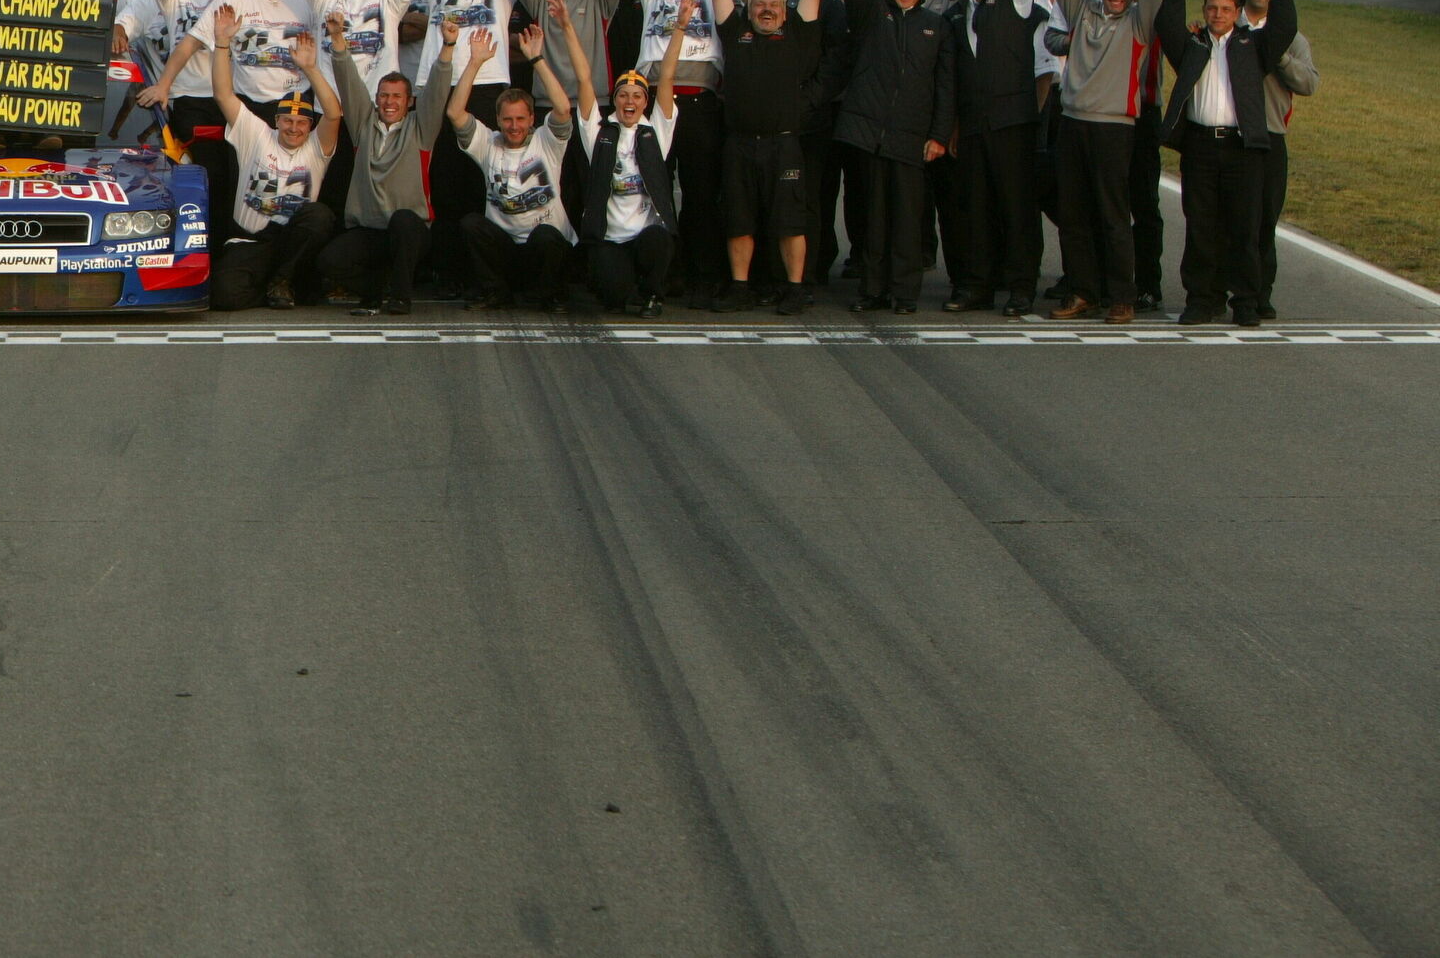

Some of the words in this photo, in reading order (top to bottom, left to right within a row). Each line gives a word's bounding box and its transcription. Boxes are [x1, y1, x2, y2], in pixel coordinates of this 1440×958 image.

[5, 60, 29, 89] ÄR
[31, 62, 73, 91] BÄST
[24, 98, 82, 127] POWER
[19, 179, 128, 205] Bull
[116, 237, 170, 253] DUNLOP
[184, 234, 208, 248] ABT
[144, 256, 169, 266] Castrol
